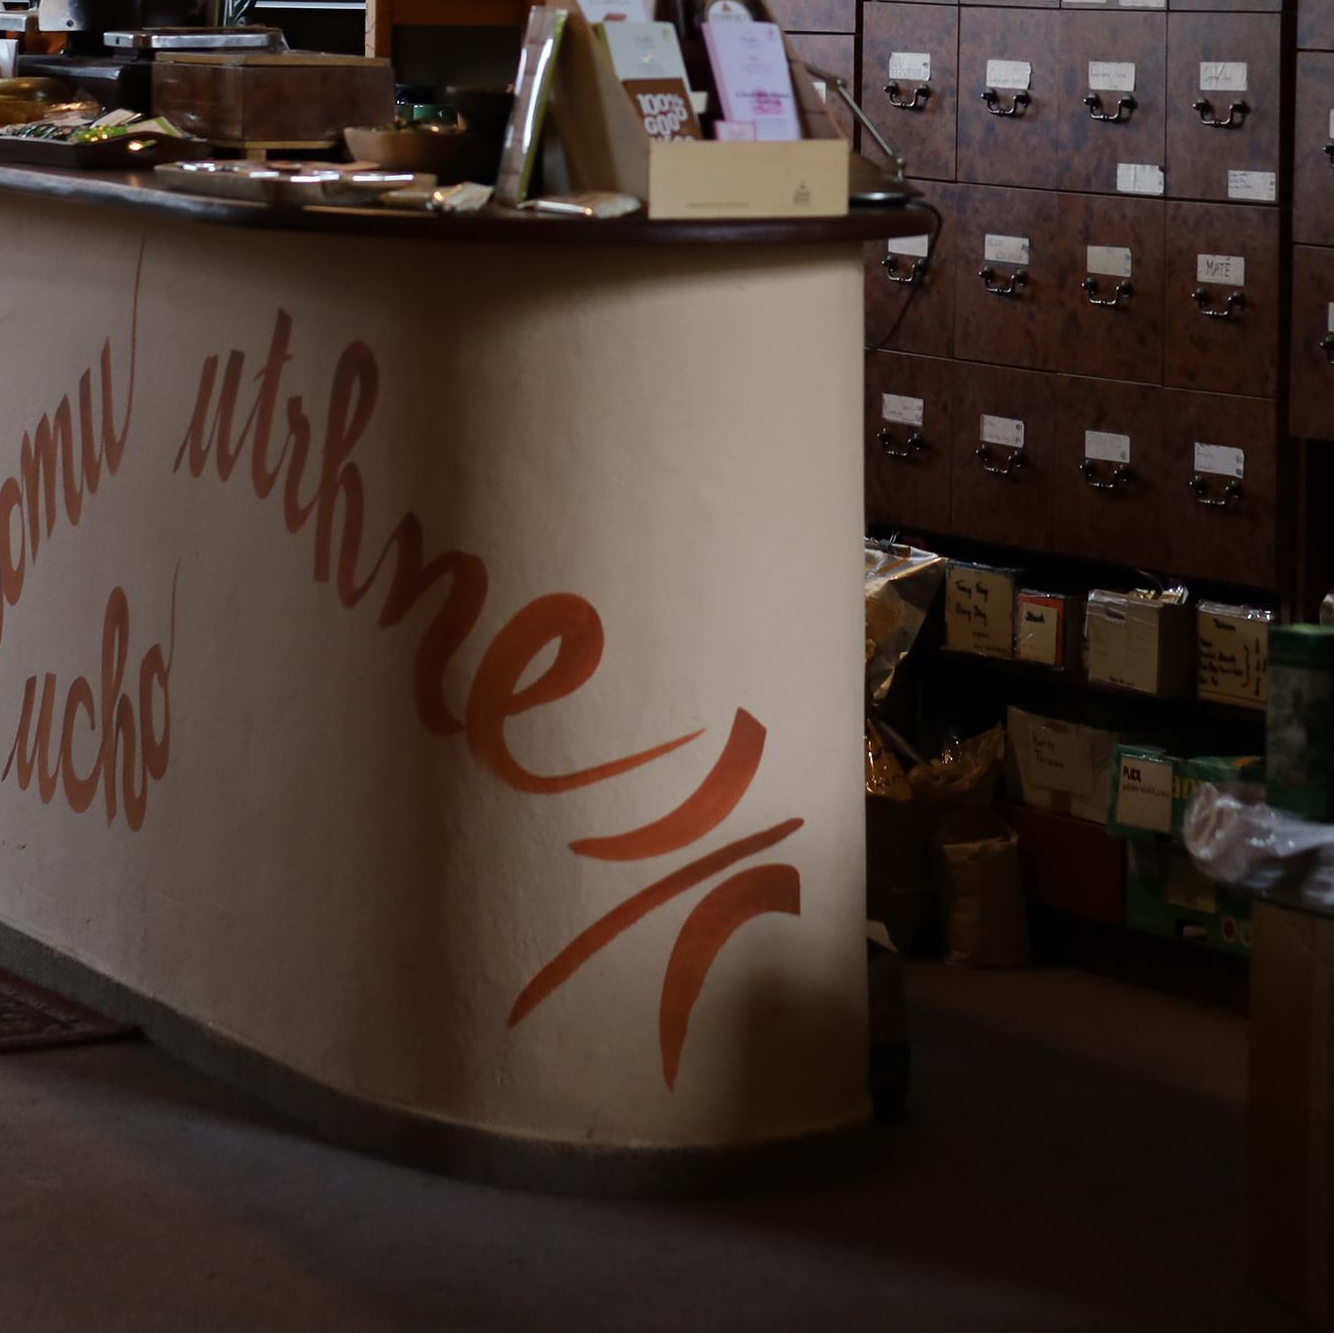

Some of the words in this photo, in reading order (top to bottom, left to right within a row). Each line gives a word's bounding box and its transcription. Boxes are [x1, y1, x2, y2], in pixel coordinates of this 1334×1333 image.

[1206, 259, 1231, 278] MATE
[1, 559, 181, 833] ucho
[172, 307, 707, 795] utrhne
